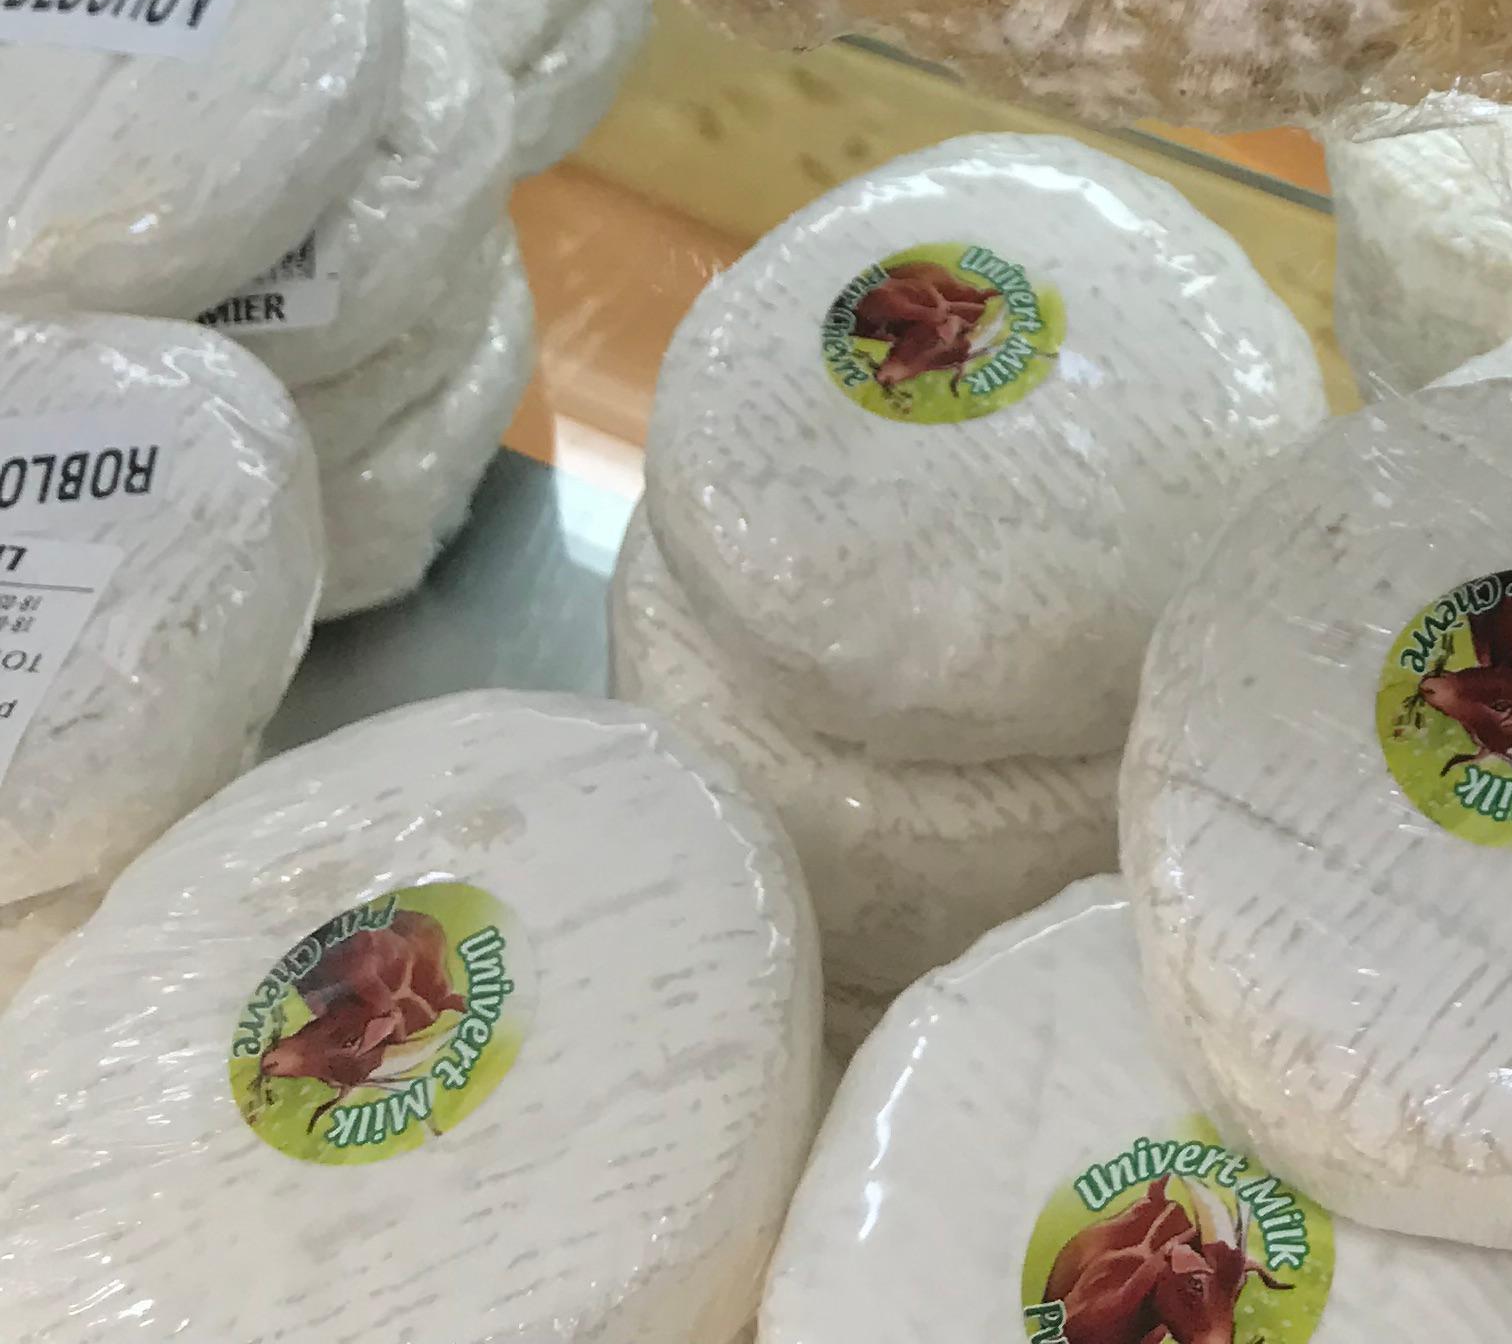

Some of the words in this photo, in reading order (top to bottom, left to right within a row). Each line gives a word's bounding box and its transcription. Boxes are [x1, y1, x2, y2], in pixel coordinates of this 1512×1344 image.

[433, 925, 515, 1090] Univert
[324, 1078, 434, 1147] Milk
[1073, 1135, 1251, 1213] Univert
[1238, 1174, 1311, 1272] Milk
